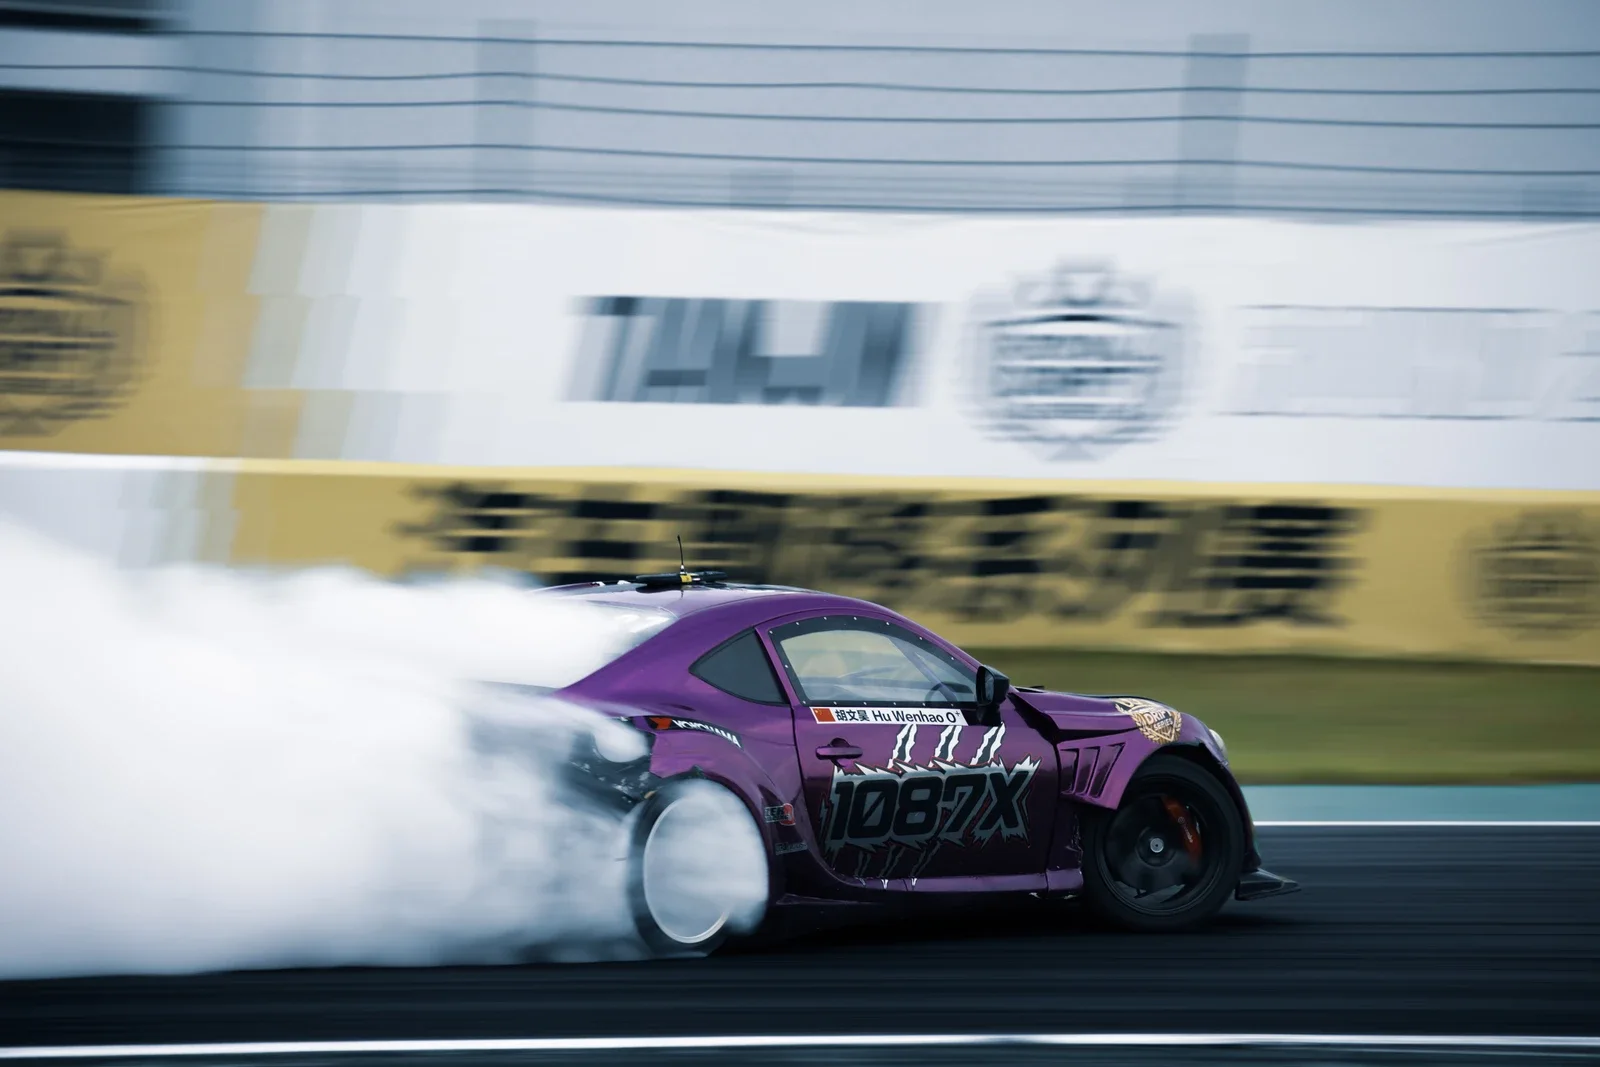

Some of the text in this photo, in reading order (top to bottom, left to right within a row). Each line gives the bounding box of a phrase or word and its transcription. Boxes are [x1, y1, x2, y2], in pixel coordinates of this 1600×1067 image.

[834, 709, 869, 721] 胡文昊
[871, 709, 891, 722] Hu
[891, 710, 944, 723] Wenhao
[830, 770, 1030, 841] 1087X
